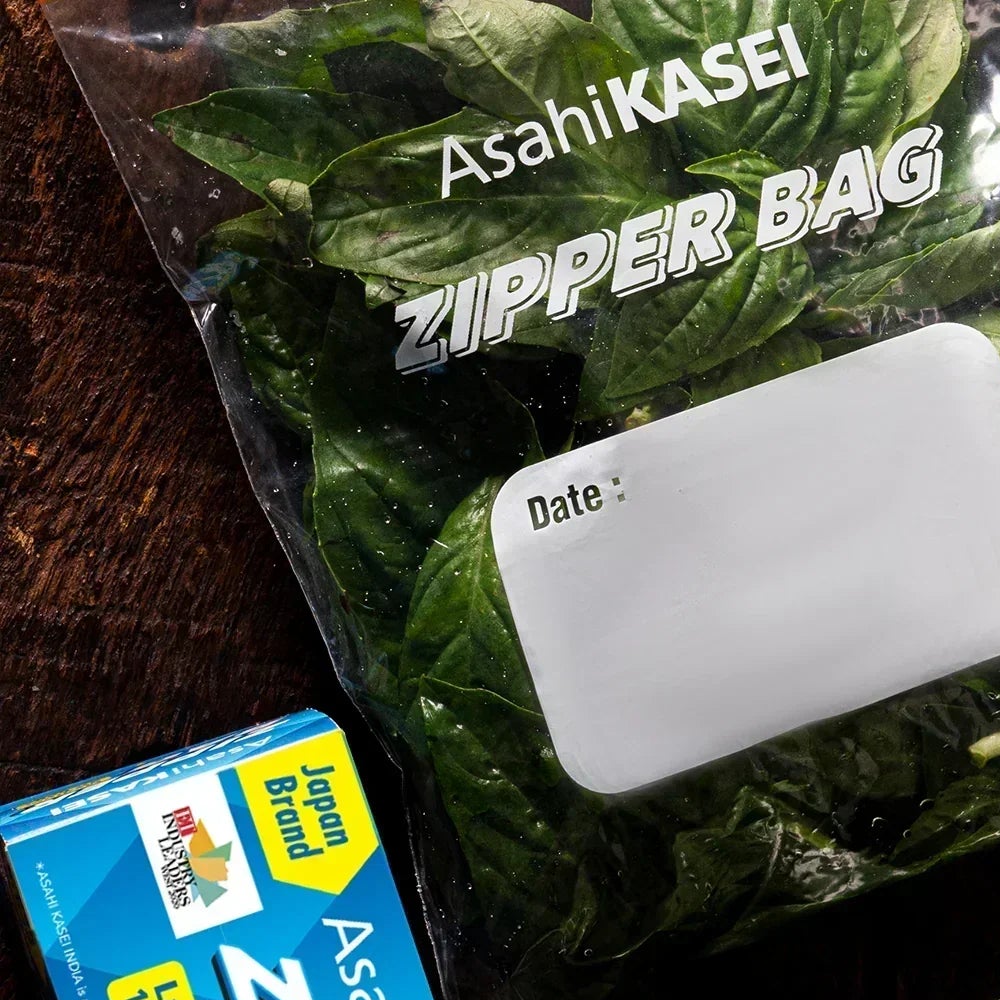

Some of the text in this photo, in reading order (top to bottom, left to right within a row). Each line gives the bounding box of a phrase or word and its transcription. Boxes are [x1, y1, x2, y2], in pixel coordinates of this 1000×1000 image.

[440, 23, 810, 198] AsahiKASEI
[394, 124, 943, 375] ZIPPER BAG
[527, 482, 602, 531] Date
[50, 736, 272, 816] AsahiKASEI
[300, 765, 349, 847] Japan
[162, 812, 197, 886] INDUSTRY
[264, 775, 324, 860] Brand
[158, 837, 191, 907] LEADERS
[51, 910, 72, 947] KASEI
[63, 948, 84, 986] INDIA
[77, 985, 84, 998] is
